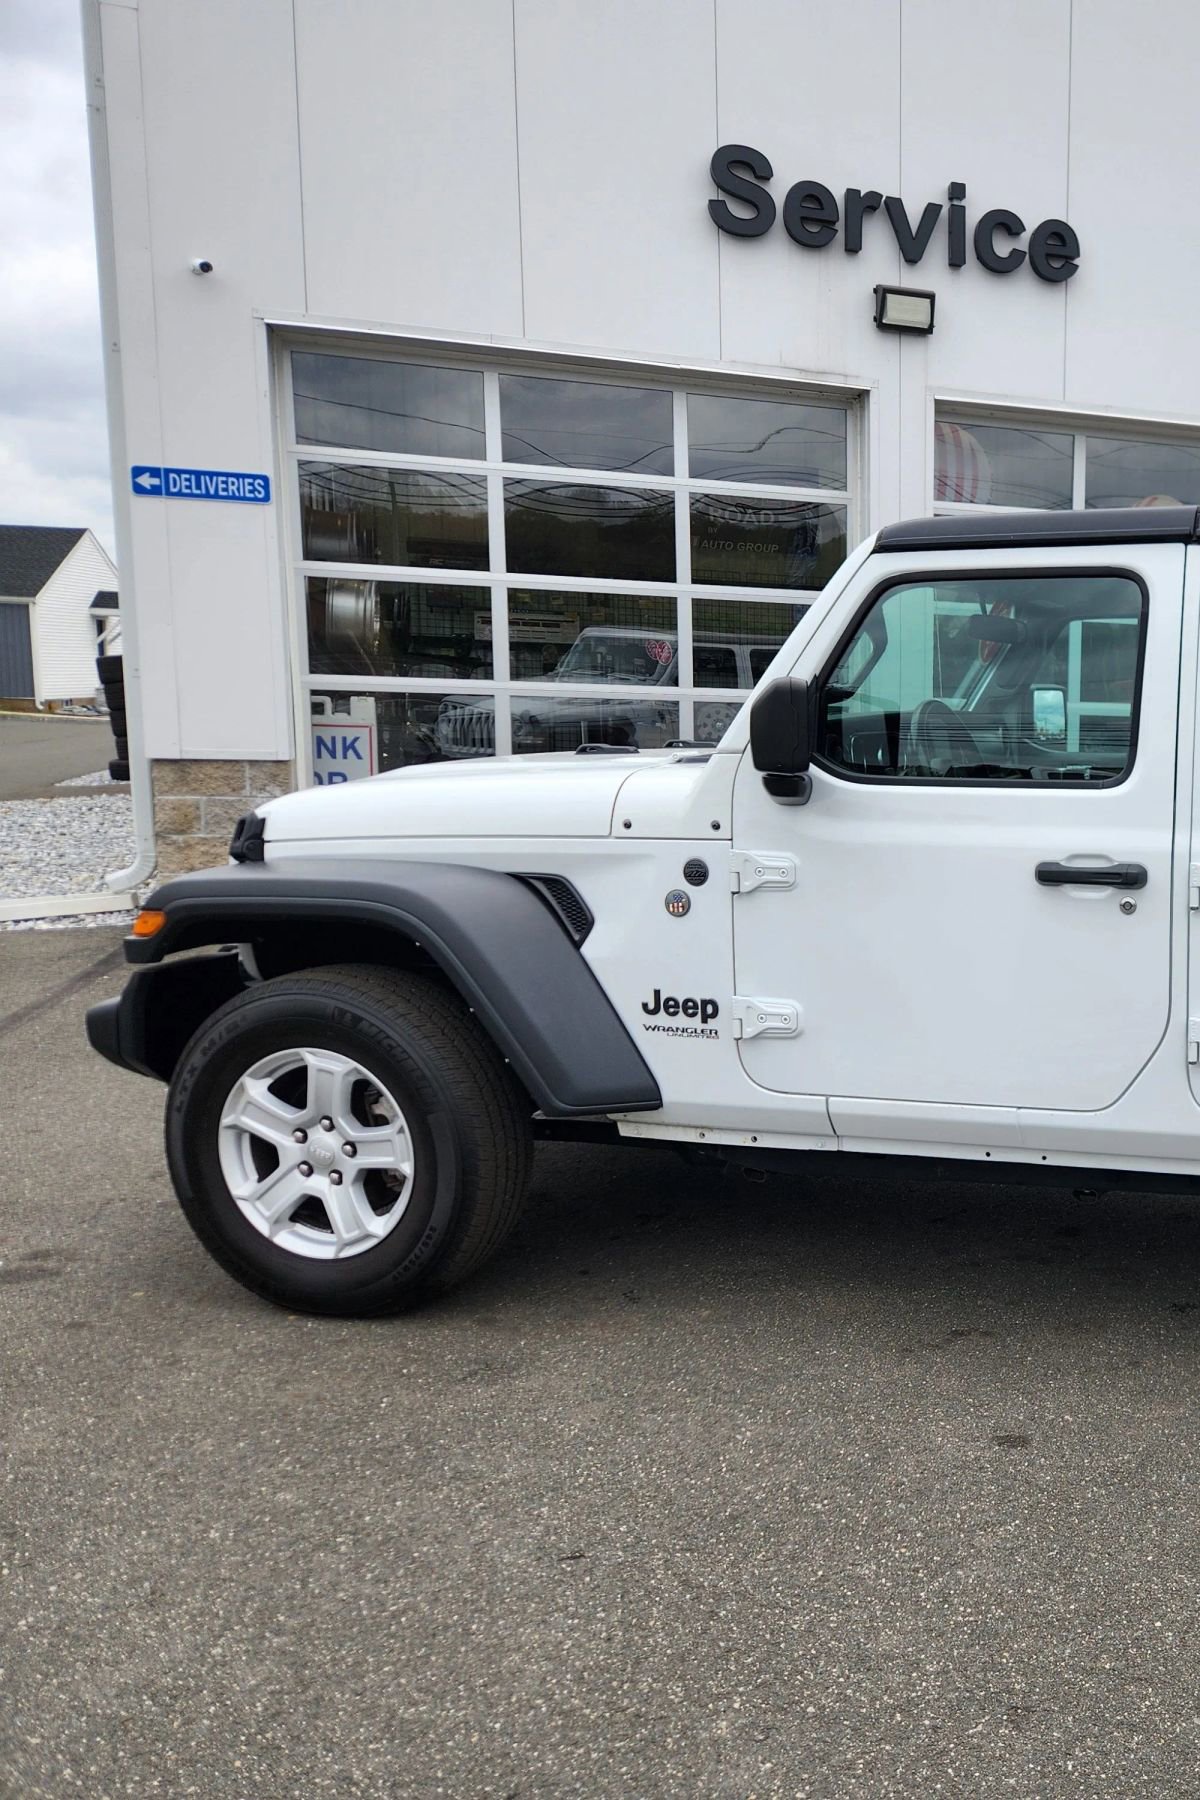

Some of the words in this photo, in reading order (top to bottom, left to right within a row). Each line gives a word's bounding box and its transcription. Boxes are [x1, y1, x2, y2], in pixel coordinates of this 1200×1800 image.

[708, 144, 1081, 283] Service
[169, 473, 266, 499] DELIVERIES
[702, 539, 734, 551] AUTO
[737, 543, 780, 553] GROUP
[641, 988, 719, 1024] Jeep
[642, 1023, 719, 1036] WRANGLER
